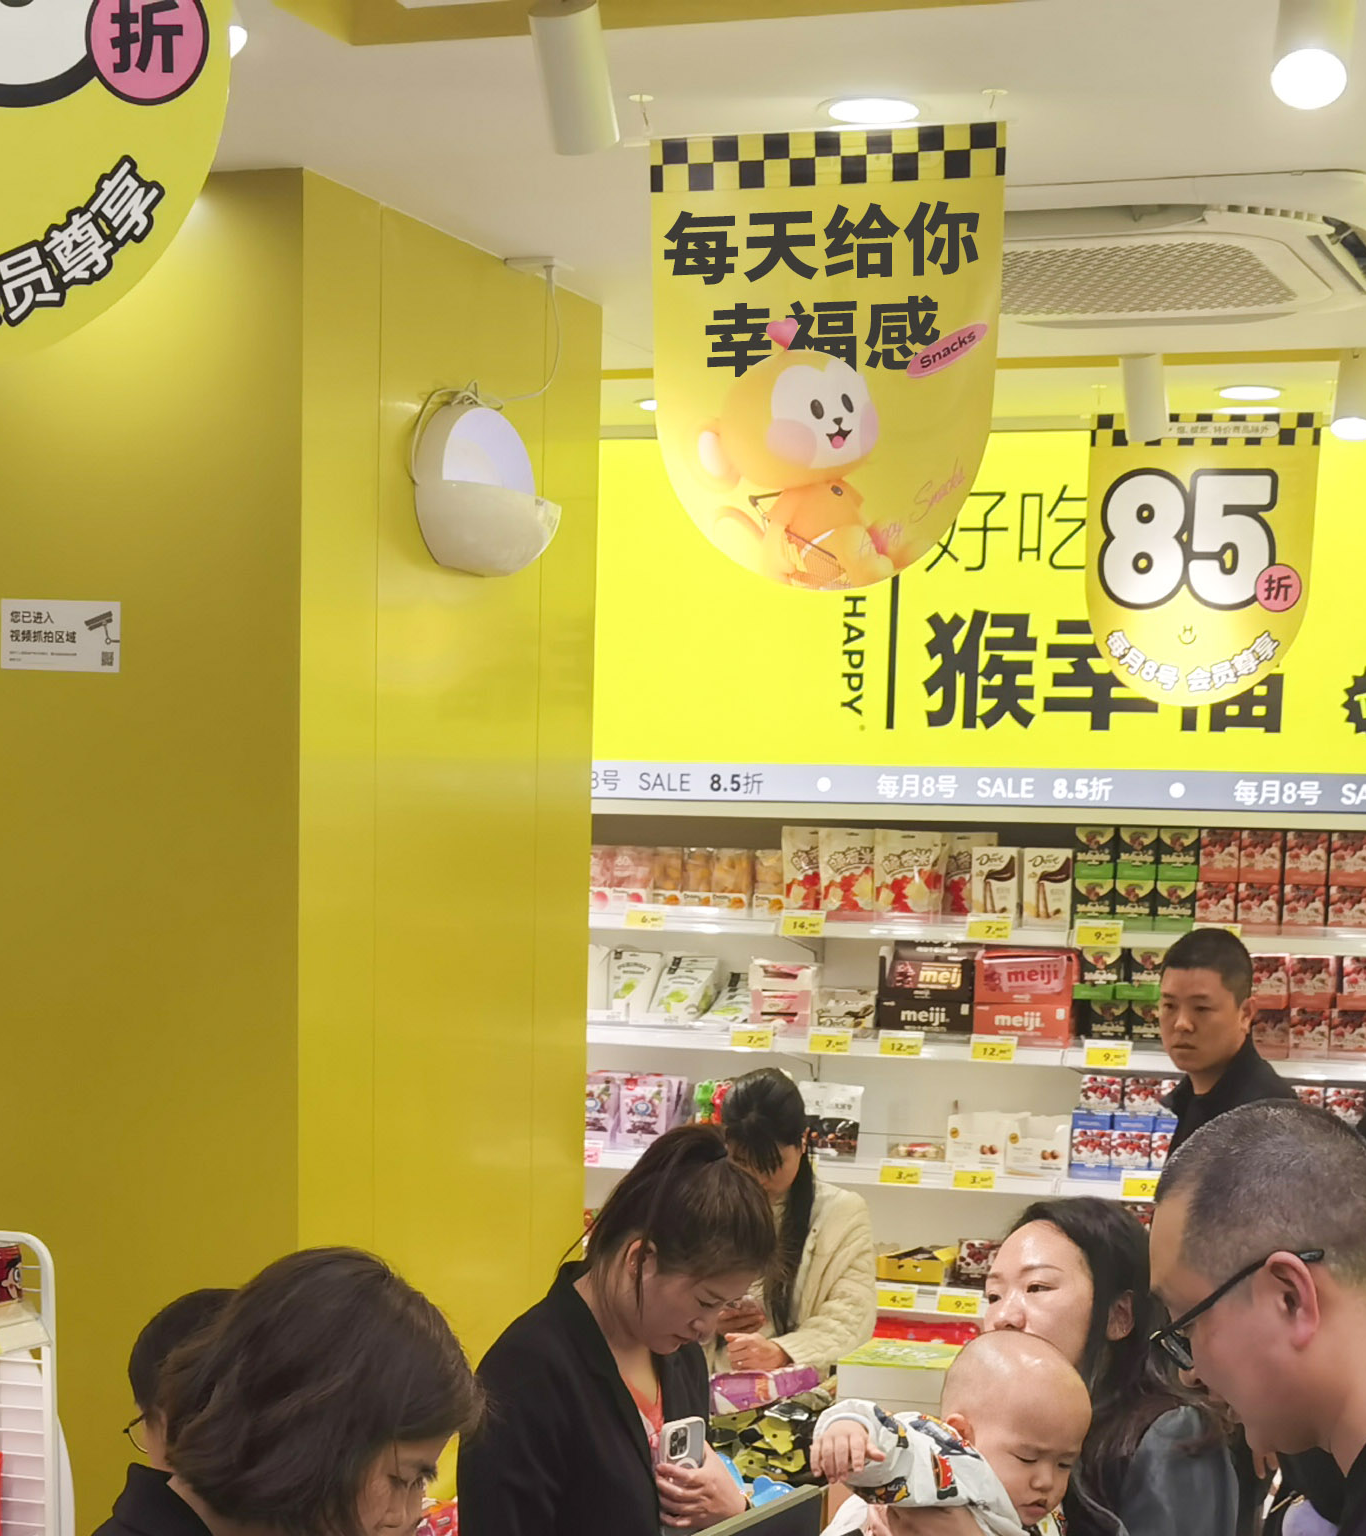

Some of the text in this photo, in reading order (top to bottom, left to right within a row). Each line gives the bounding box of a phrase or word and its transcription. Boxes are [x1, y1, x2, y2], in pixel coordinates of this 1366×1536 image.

[109, 0, 184, 74] 折
[664, 201, 980, 285] 每天给你
[705, 295, 941, 378] 幸福感
[920, 330, 977, 368] Snacks
[1098, 467, 1292, 611] 85 折
[10, 611, 54, 624] 您已进入
[841, 596, 867, 715] HAPPY
[1105, 630, 1281, 693] 每月8号 会员尊享
[639, 773, 691, 792] SALE
[709, 772, 764, 795] 8.5折
[876, 773, 1113, 801] 每月8号 SALE 8.5折
[1233, 780, 1321, 805] 每月8号
[1007, 962, 1059, 985] meiji
[900, 1007, 948, 1024] meiji
[994, 1011, 1042, 1029] meiji
